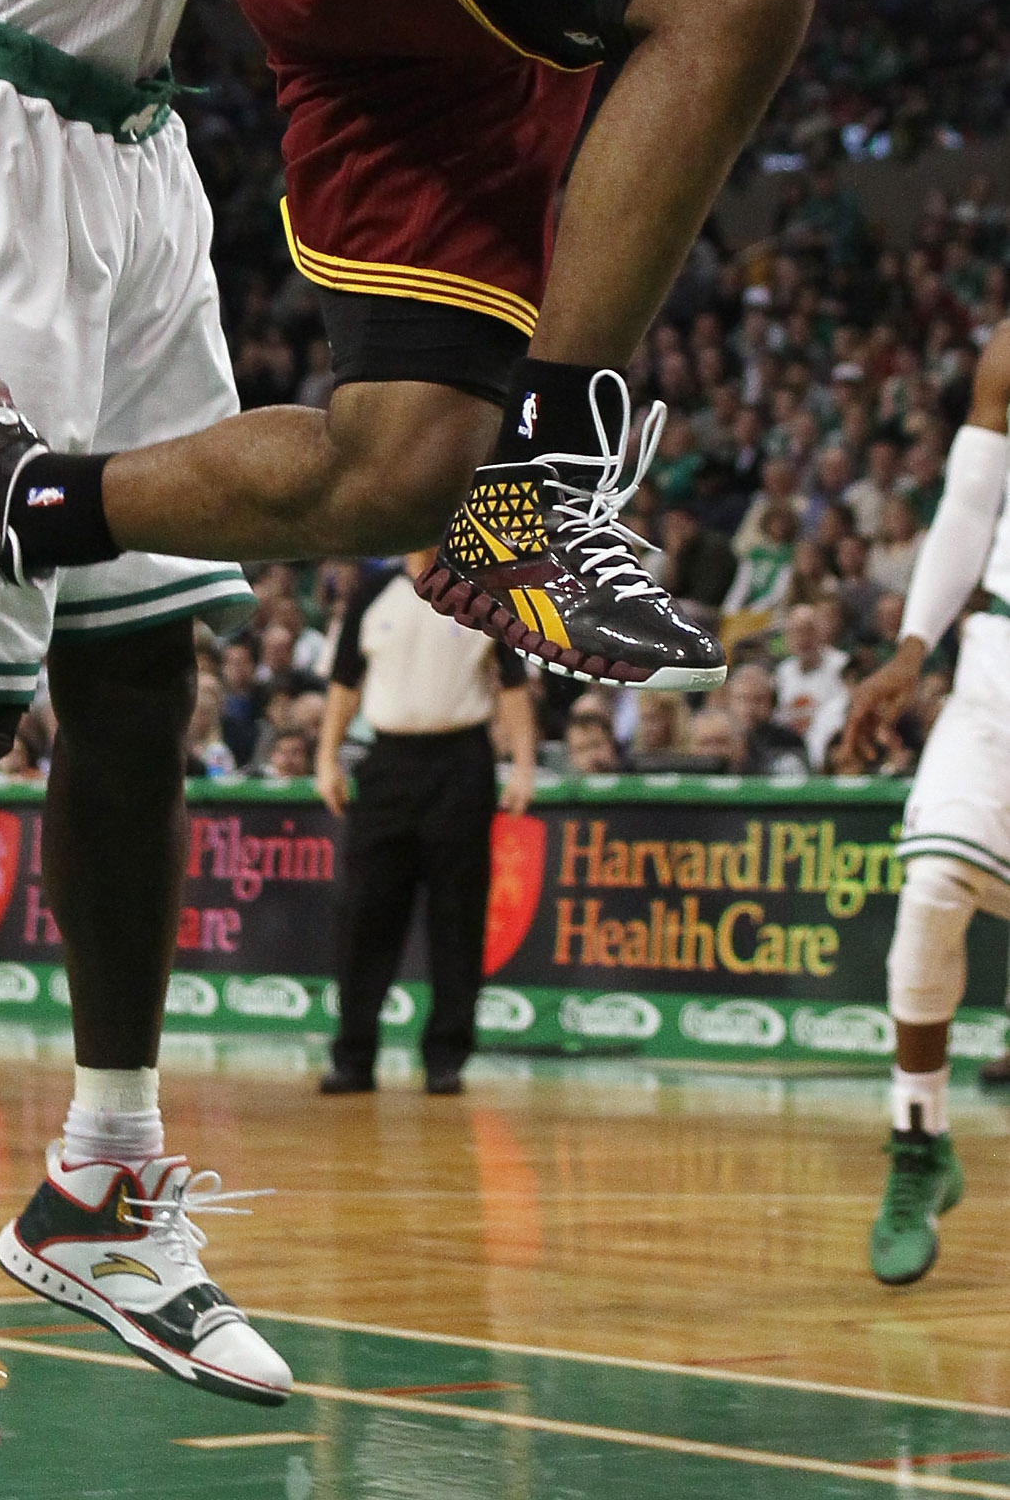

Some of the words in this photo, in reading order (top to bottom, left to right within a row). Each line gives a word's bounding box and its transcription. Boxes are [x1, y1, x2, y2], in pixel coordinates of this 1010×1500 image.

[187, 816, 334, 900] Pilgrim
[559, 819, 763, 890] Harvard
[767, 819, 904, 919] Pilgri
